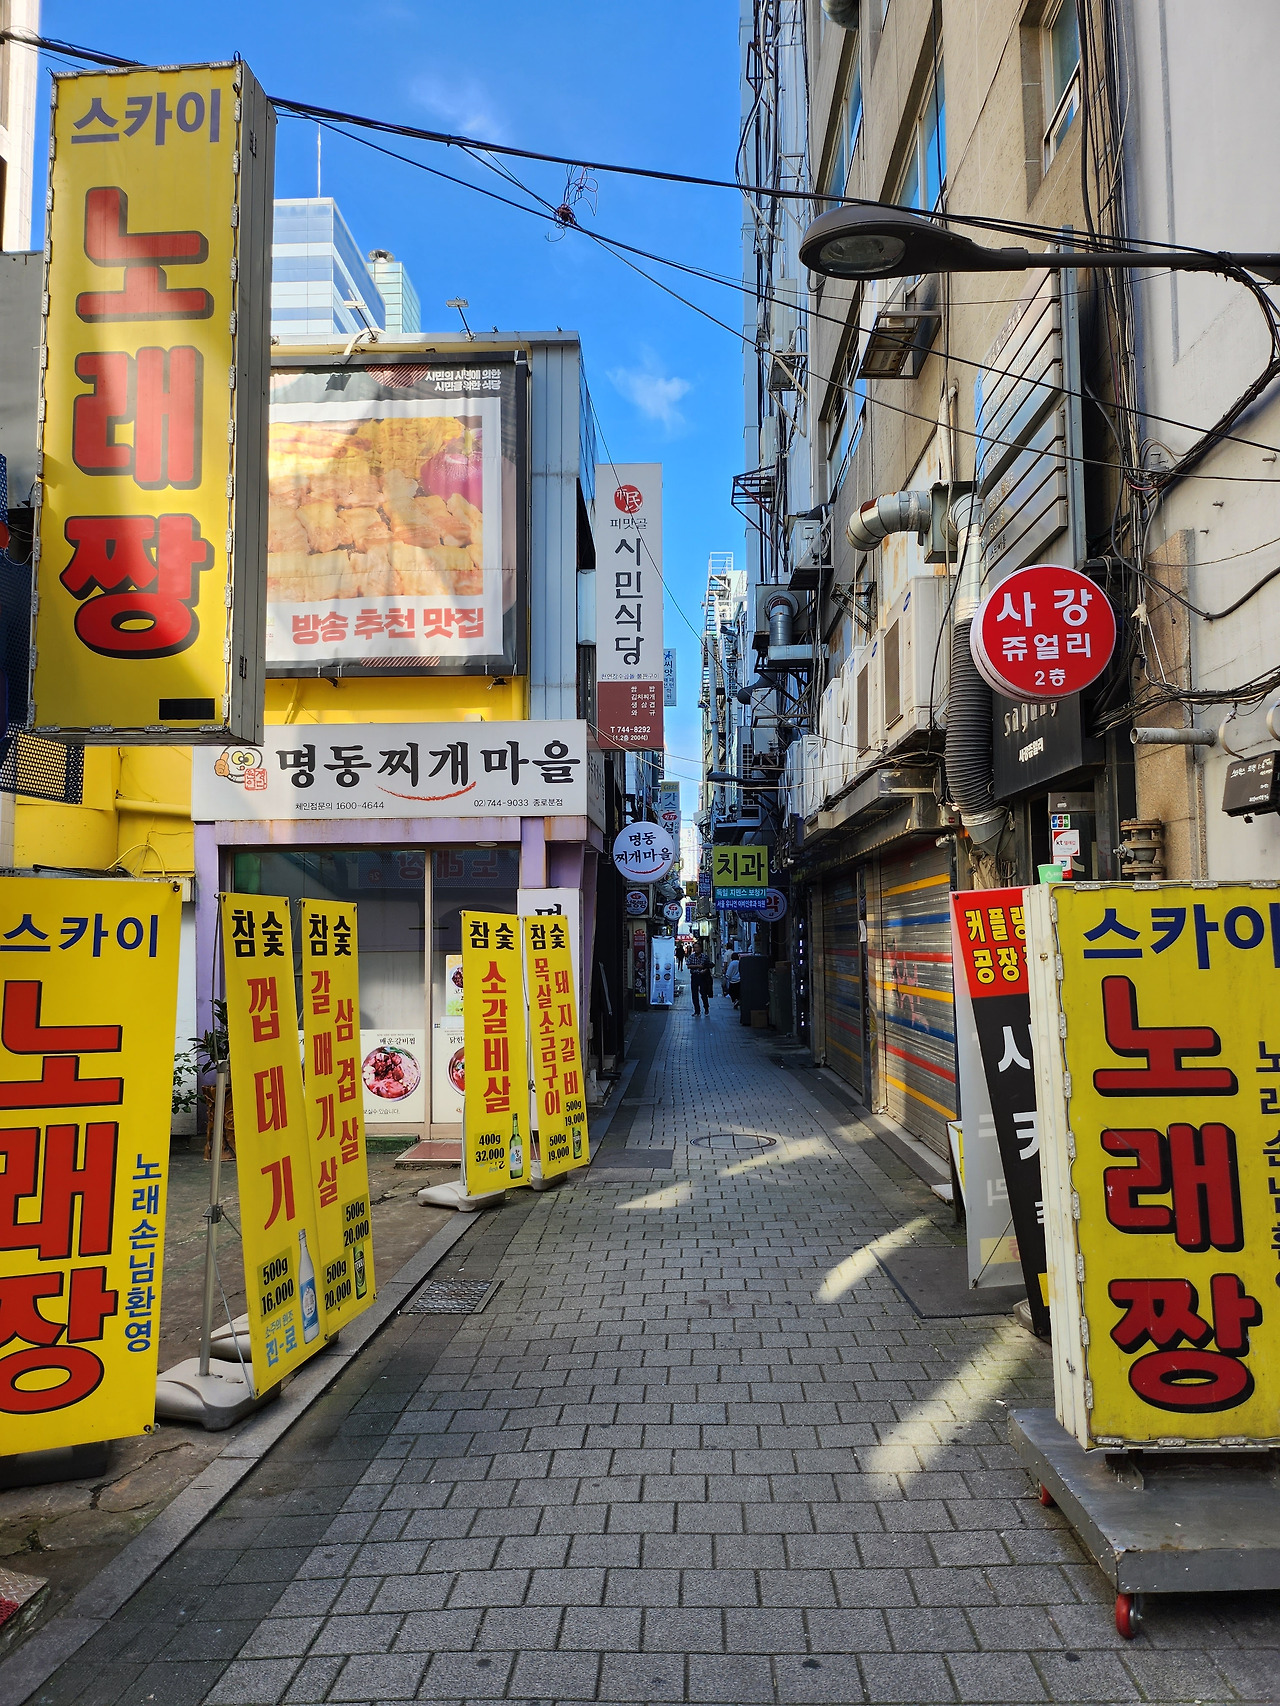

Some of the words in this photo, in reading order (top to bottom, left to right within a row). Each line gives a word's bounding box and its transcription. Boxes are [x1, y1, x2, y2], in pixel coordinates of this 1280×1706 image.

[71, 88, 222, 146] 스카이
[425, 371, 454, 381] 시민의
[482, 369, 501, 380] 의한
[434, 380, 462, 391] 시민을
[482, 380, 501, 390] 식당
[59, 186, 216, 660] 노래짱
[610, 518, 648, 530] 피맛골
[614, 537, 645, 666] 시민식당
[292, 611, 349, 645] 방송
[354, 608, 416, 640] 추천
[423, 608, 484, 639] 맛집
[1002, 633, 1092, 662] 쥬얼리
[1034, 667, 1066, 687] 2층
[295, 802, 333, 811] 체인점문의
[336, 801, 385, 810] 1600-4644
[473, 798, 529, 808] 02)744-9033
[628, 831, 657, 847] 명동
[614, 847, 673, 865] 찌개마을
[716, 852, 765, 882] 치과
[0, 913, 159, 958] 스카이
[231, 909, 285, 958] 참숯
[308, 913, 352, 957] 참숯
[469, 920, 515, 951] 참숯
[530, 923, 567, 951] 참숯
[1083, 902, 1280, 970] 스카이
[379, 1036, 416, 1046] 매운갈비찜
[481, 960, 511, 1115] 소갈비살
[534, 957, 561, 1116] 목살소금구이
[554, 970, 580, 1097] 돼지갈비
[311, 970, 339, 1209] 갈매기살
[334, 998, 360, 1166] 삼겹살
[246, 976, 297, 1231] 껍데기
[565, 1099, 582, 1113] 500g
[564, 1111, 586, 1127] 19,000
[478, 1132, 502, 1147] 400g
[547, 1145, 571, 1162] 19,000
[549, 1133, 567, 1147] 500g
[475, 1147, 506, 1163] 32,000
[1093, 975, 1263, 1414] 노래짱
[345, 1200, 366, 1223] 500g
[343, 1219, 370, 1248] 20,000
[262, 1256, 288, 1287] 500g
[326, 1260, 348, 1285] 500g
[261, 1278, 295, 1317] 16,000
[324, 1278, 352, 1312] 20,000
